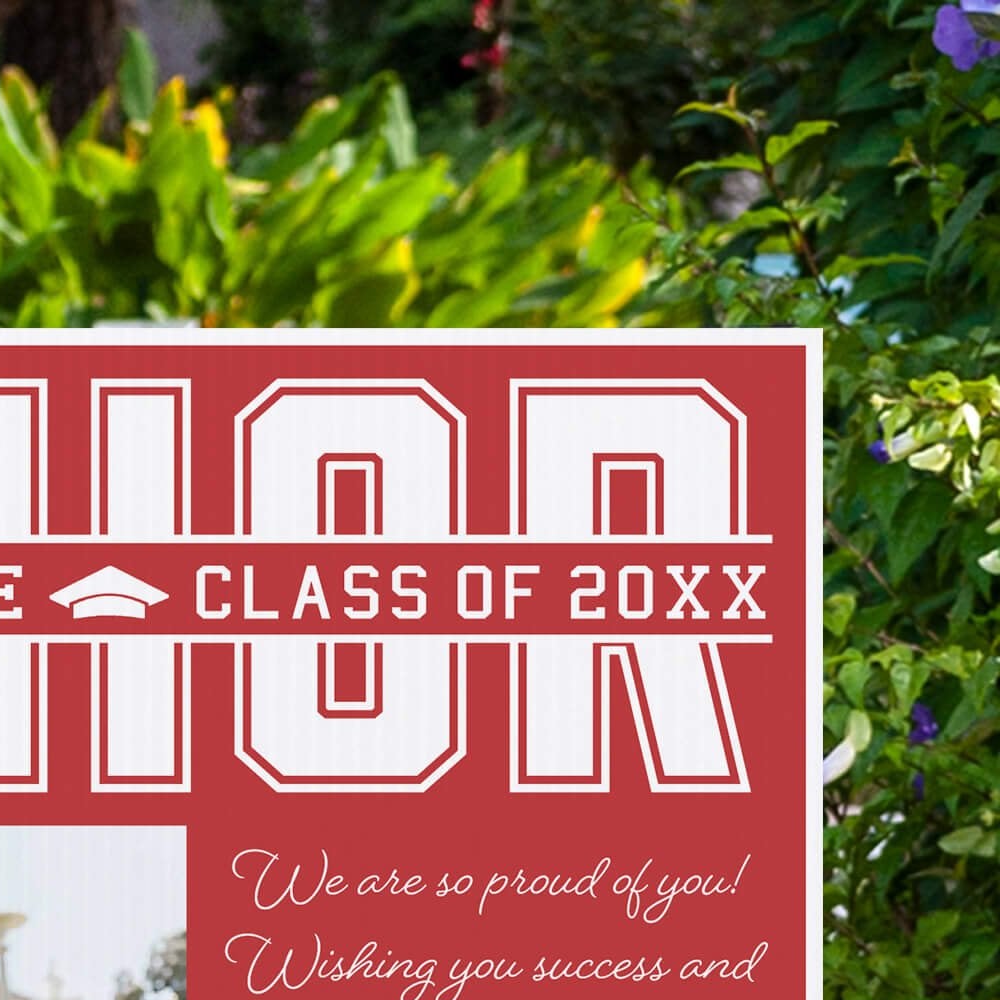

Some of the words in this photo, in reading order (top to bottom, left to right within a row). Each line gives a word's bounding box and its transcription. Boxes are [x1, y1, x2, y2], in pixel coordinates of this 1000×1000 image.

[196, 565, 427, 620] CLASS
[457, 565, 541, 620] OF
[570, 565, 767, 620] 20XX
[232, 848, 348, 911] We
[357, 869, 427, 896] are
[436, 872, 473, 897] so
[479, 857, 609, 916] proud
[612, 858, 653, 920] of
[643, 854, 752, 924] you!
[532, 957, 672, 982] success
[680, 942, 769, 983] and
